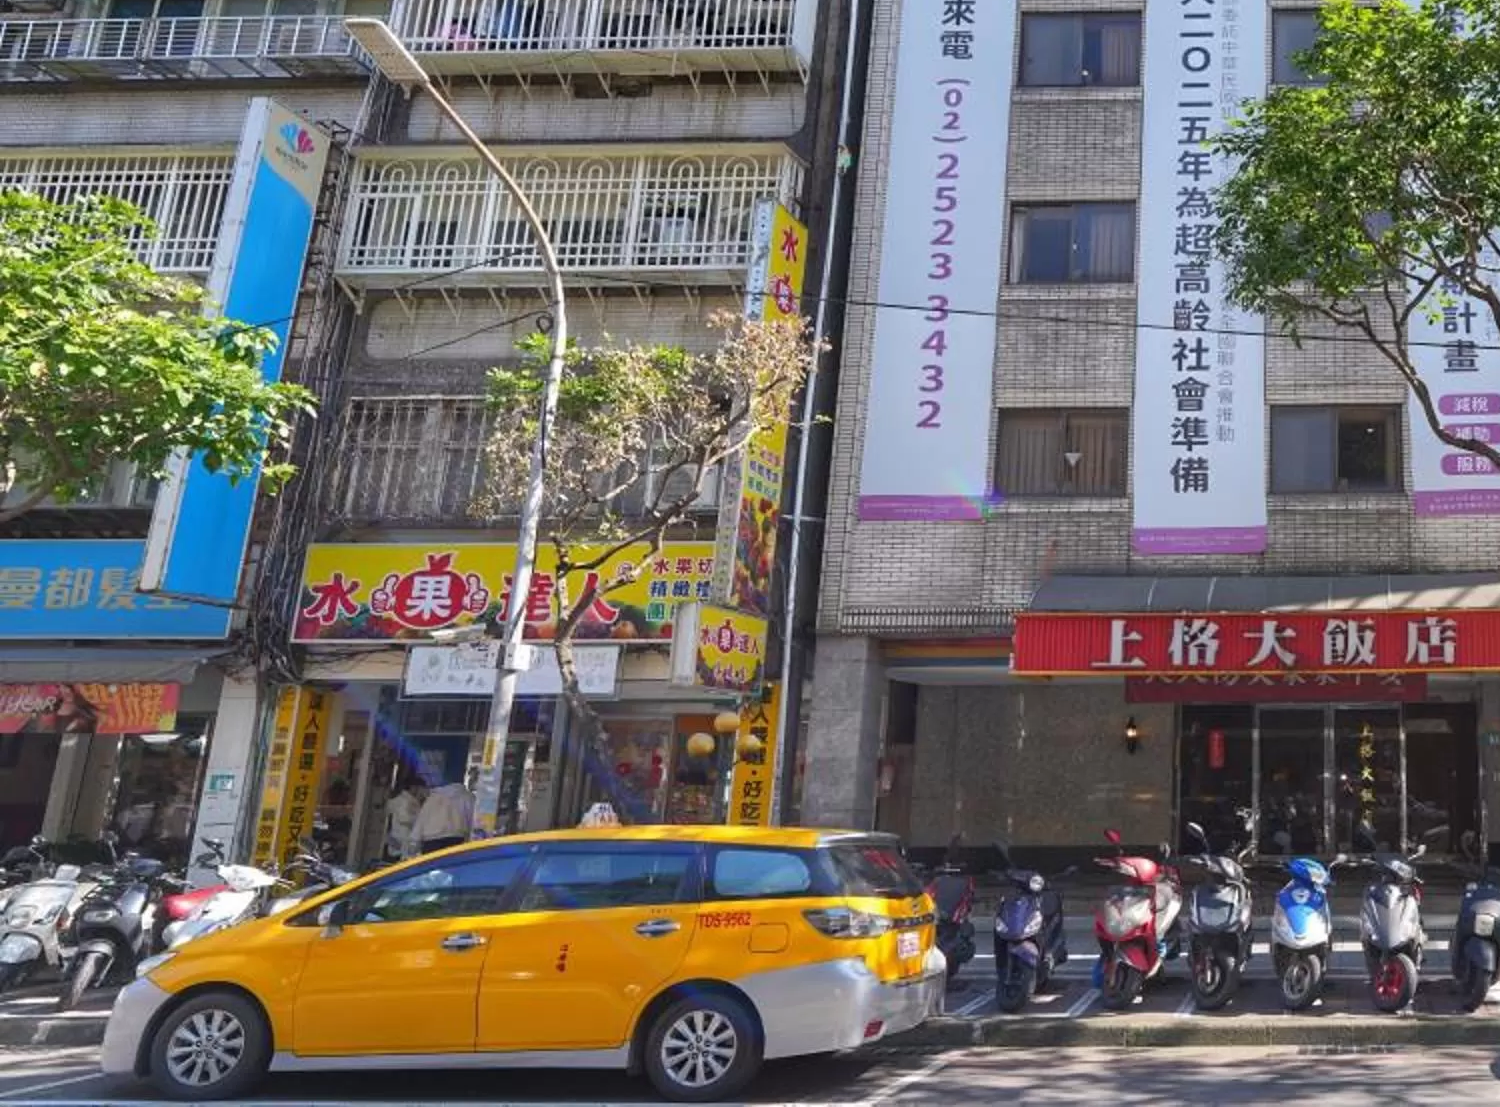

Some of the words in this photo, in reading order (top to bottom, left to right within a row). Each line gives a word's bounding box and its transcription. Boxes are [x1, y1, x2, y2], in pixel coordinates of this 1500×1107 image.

[0, 567, 192, 611] 曼都髮
[304, 572, 619, 626] 水果達人
[1091, 615, 1457, 668] 上格大飯店
